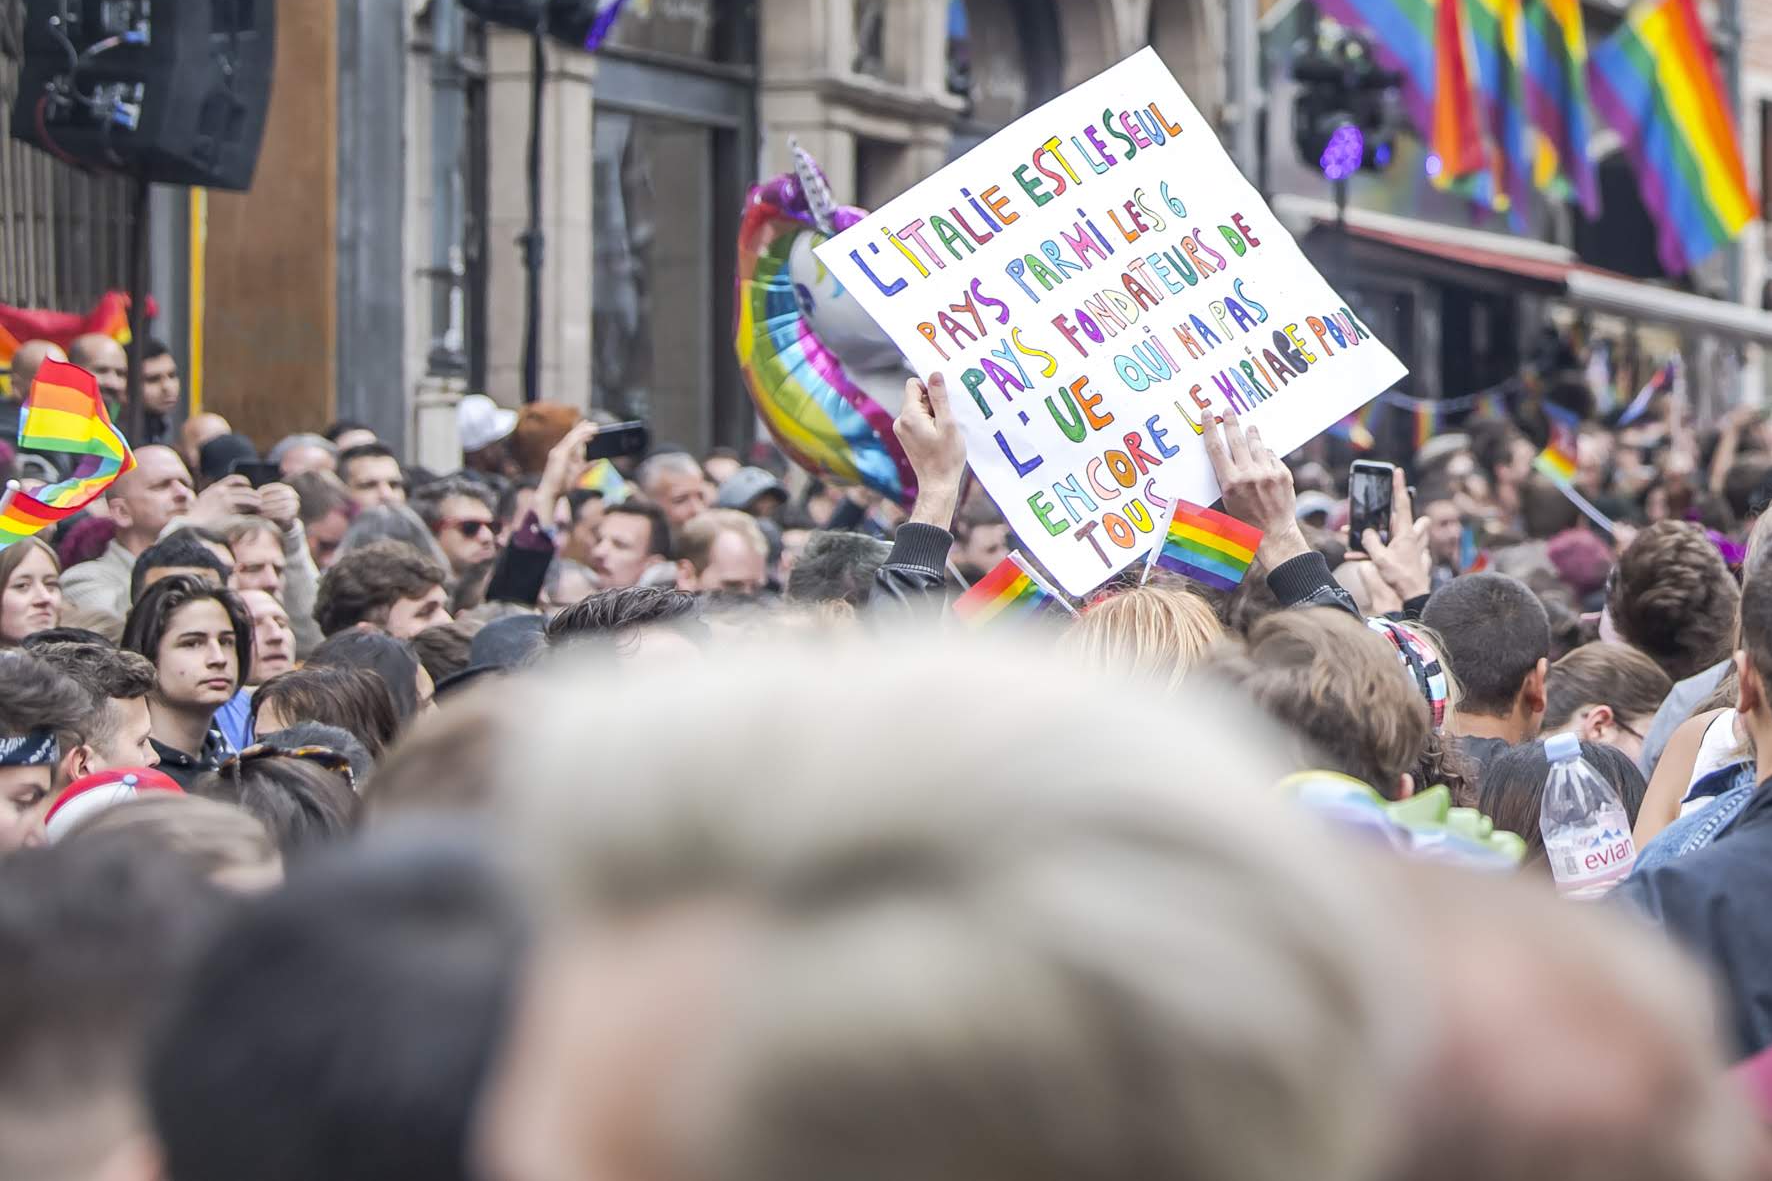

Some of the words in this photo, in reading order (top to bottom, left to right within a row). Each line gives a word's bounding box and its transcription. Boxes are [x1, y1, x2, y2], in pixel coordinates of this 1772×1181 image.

[1012, 135, 1082, 207] EST
[916, 277, 1010, 361] PAYS
[1107, 188, 1167, 243] LES
[1160, 180, 1188, 218] 6
[960, 326, 1058, 420] PAYS
[1051, 227, 1227, 358] FONDATEURS
[1217, 212, 1261, 257] DE
[1208, 278, 1269, 341] PAS
[1027, 413, 1180, 537] ENCORE
[1304, 307, 1370, 357] POUR
[1584, 838, 1632, 870] evian
